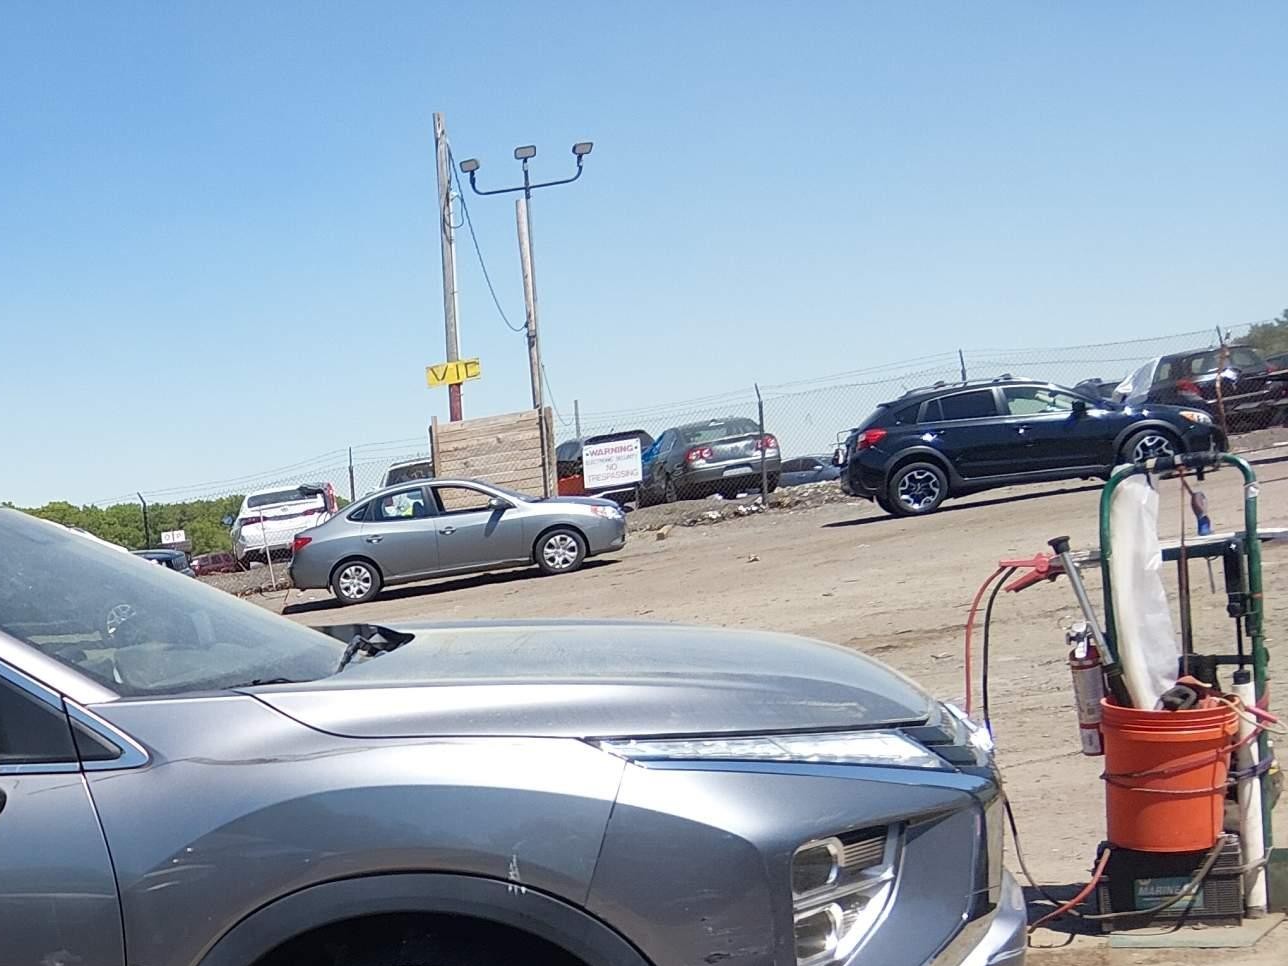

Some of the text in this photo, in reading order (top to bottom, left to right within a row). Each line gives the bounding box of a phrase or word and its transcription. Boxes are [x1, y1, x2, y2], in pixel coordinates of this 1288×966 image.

[430, 361, 480, 381] VIC
[589, 445, 633, 456] WARNING
[606, 463, 617, 471] NO
[589, 469, 638, 482] TRESPASSING
[1138, 884, 1181, 896] MARINE
